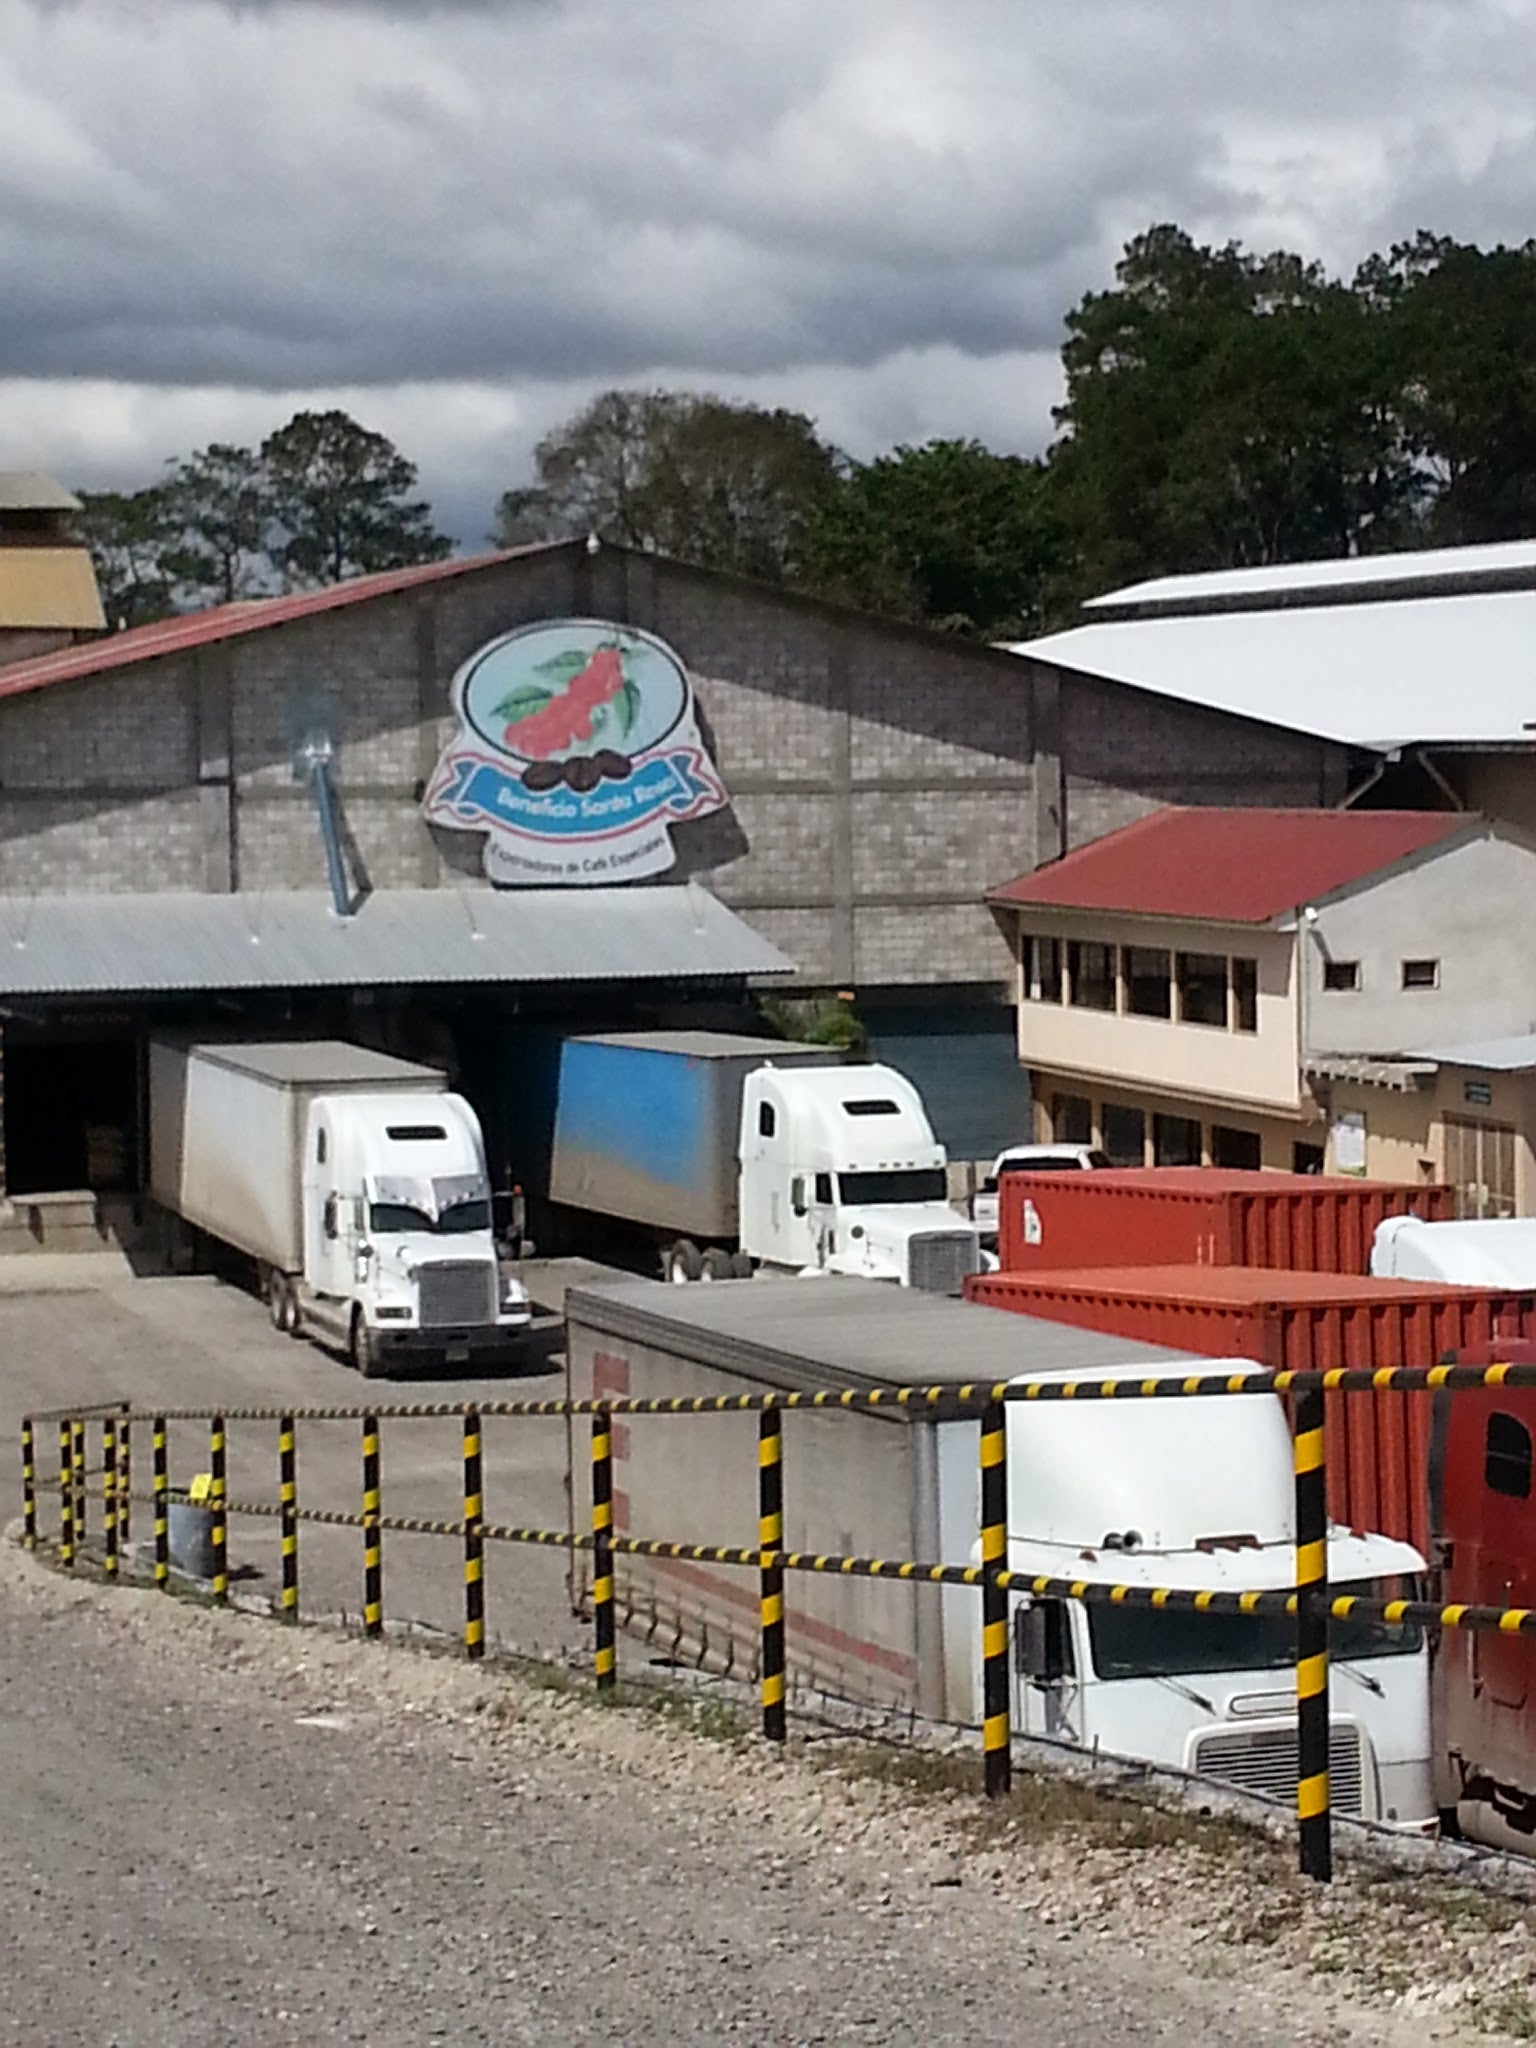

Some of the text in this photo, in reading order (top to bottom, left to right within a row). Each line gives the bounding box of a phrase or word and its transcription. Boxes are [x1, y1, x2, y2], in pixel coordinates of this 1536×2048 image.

[497, 786, 577, 818] Beneficio
[580, 794, 633, 817] Santa
[490, 842, 563, 872] Exportadores
[566, 862, 579, 872] de
[609, 836, 666, 868] Especiales
